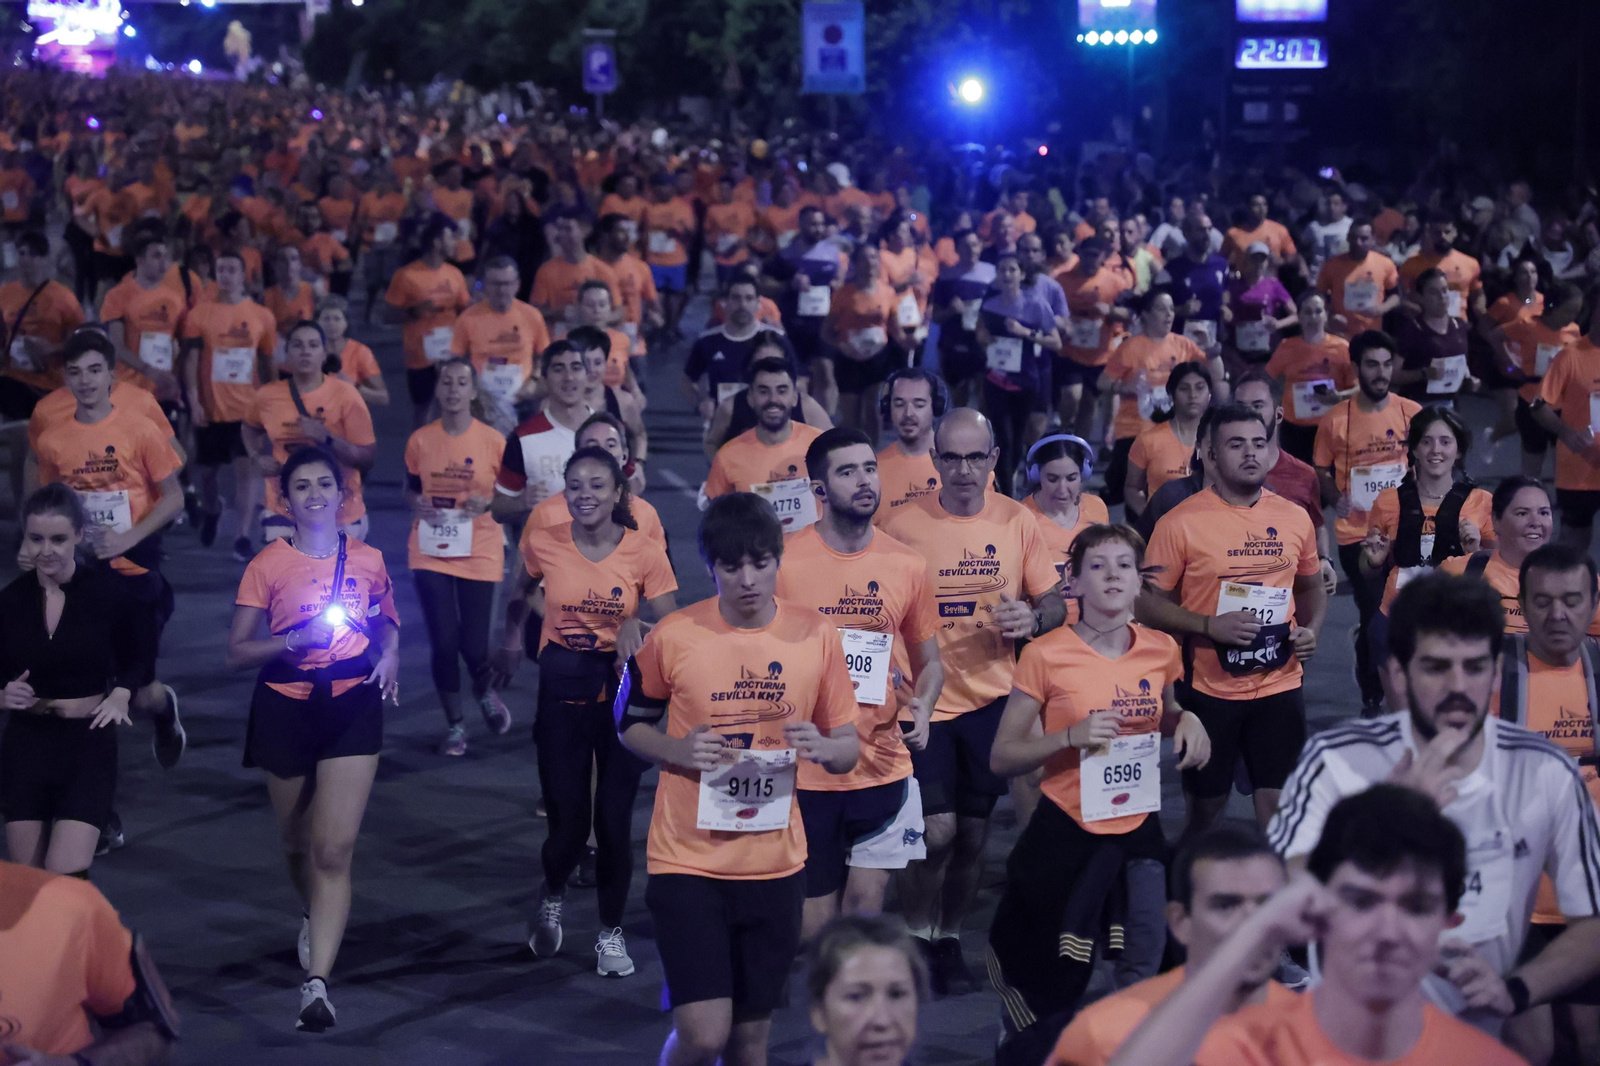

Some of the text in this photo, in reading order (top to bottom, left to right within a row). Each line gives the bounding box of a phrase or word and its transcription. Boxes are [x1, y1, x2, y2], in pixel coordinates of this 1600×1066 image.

[1240, 38, 1321, 62] 22:07
[1244, 541, 1284, 549] NOCTURNA
[1227, 549, 1263, 557] SEVILLA
[938, 568, 977, 577] SEVILLA
[581, 599, 625, 609] NOCTURNA
[838, 597, 883, 606] NOCTURNA
[561, 604, 599, 614] SEVILLA
[818, 606, 858, 615] SEVILLA
[734, 680, 786, 690] NOCTURNA
[711, 691, 755, 701] SEVILLA
[1111, 697, 1158, 707] NOCTURNA
[1103, 762, 1142, 784] 6596
[728, 776, 774, 797] 9115
